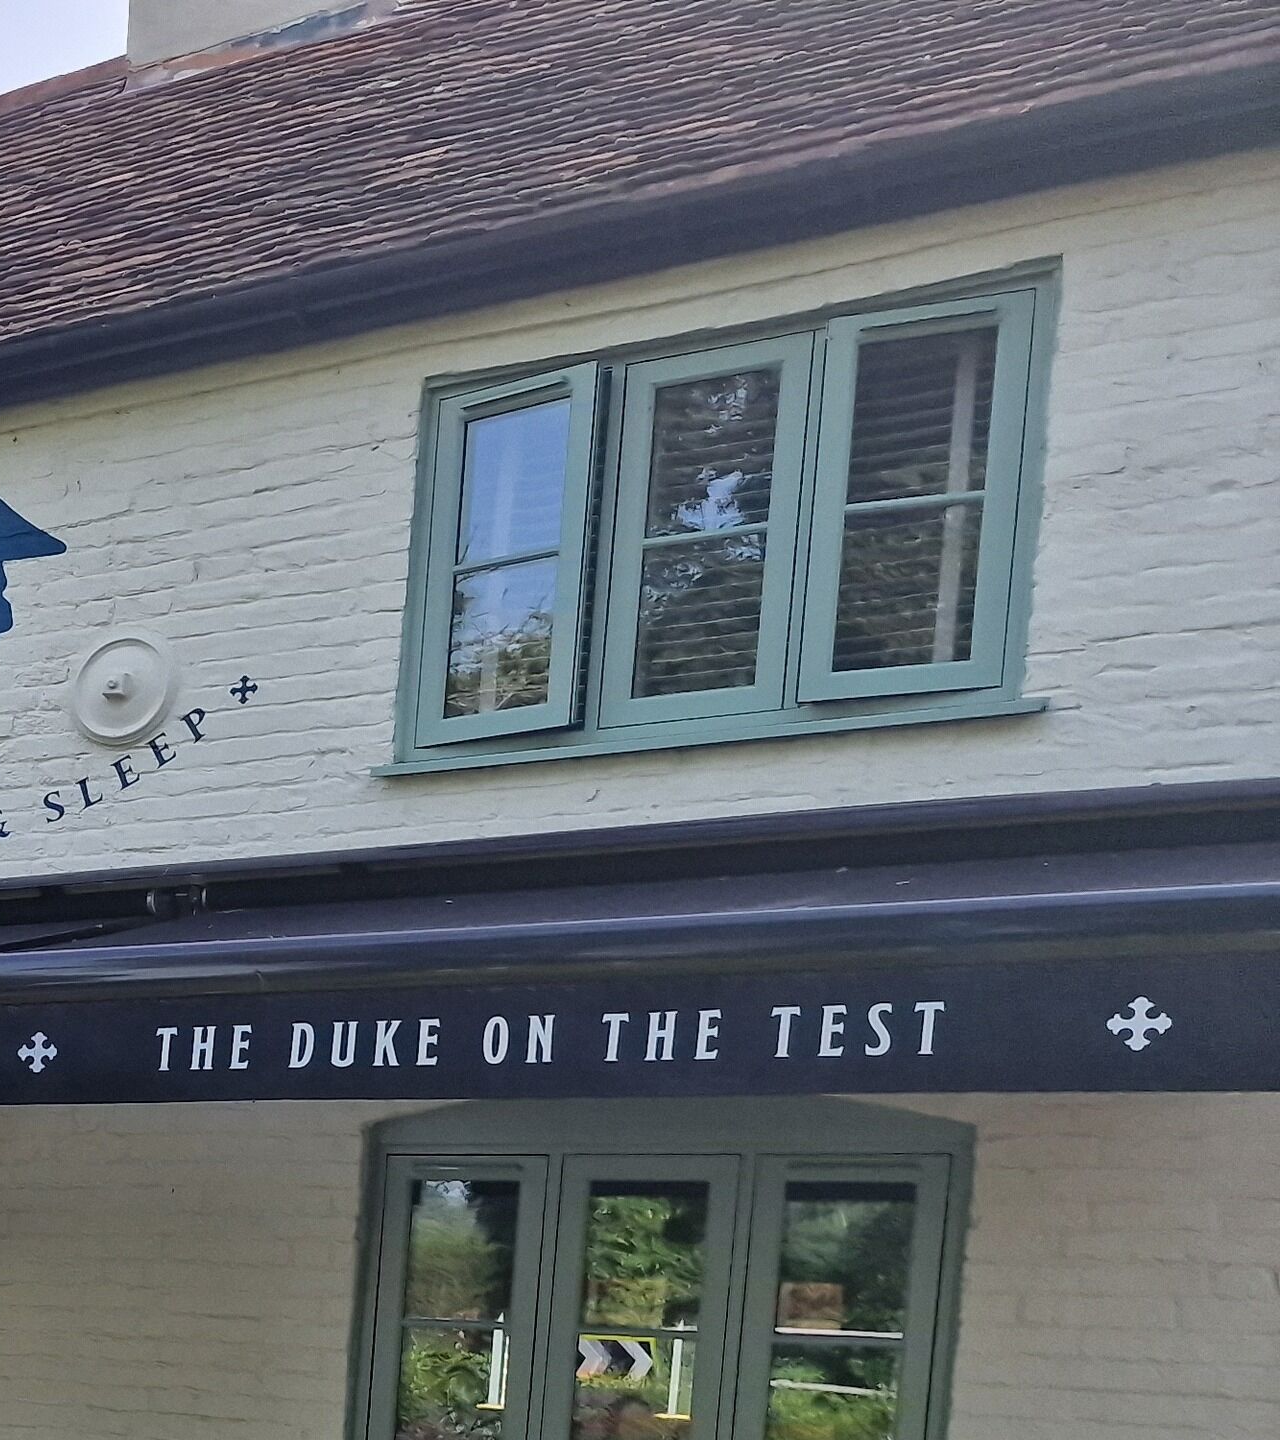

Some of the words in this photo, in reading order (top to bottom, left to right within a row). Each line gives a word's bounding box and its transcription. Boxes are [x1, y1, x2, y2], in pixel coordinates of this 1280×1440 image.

[43, 708, 207, 824] SLEEP
[155, 1024, 252, 1071] THE
[287, 1018, 441, 1068] DUKE
[482, 1014, 556, 1065] ON
[601, 1008, 722, 1062] THE
[770, 1001, 945, 1058] TEST
